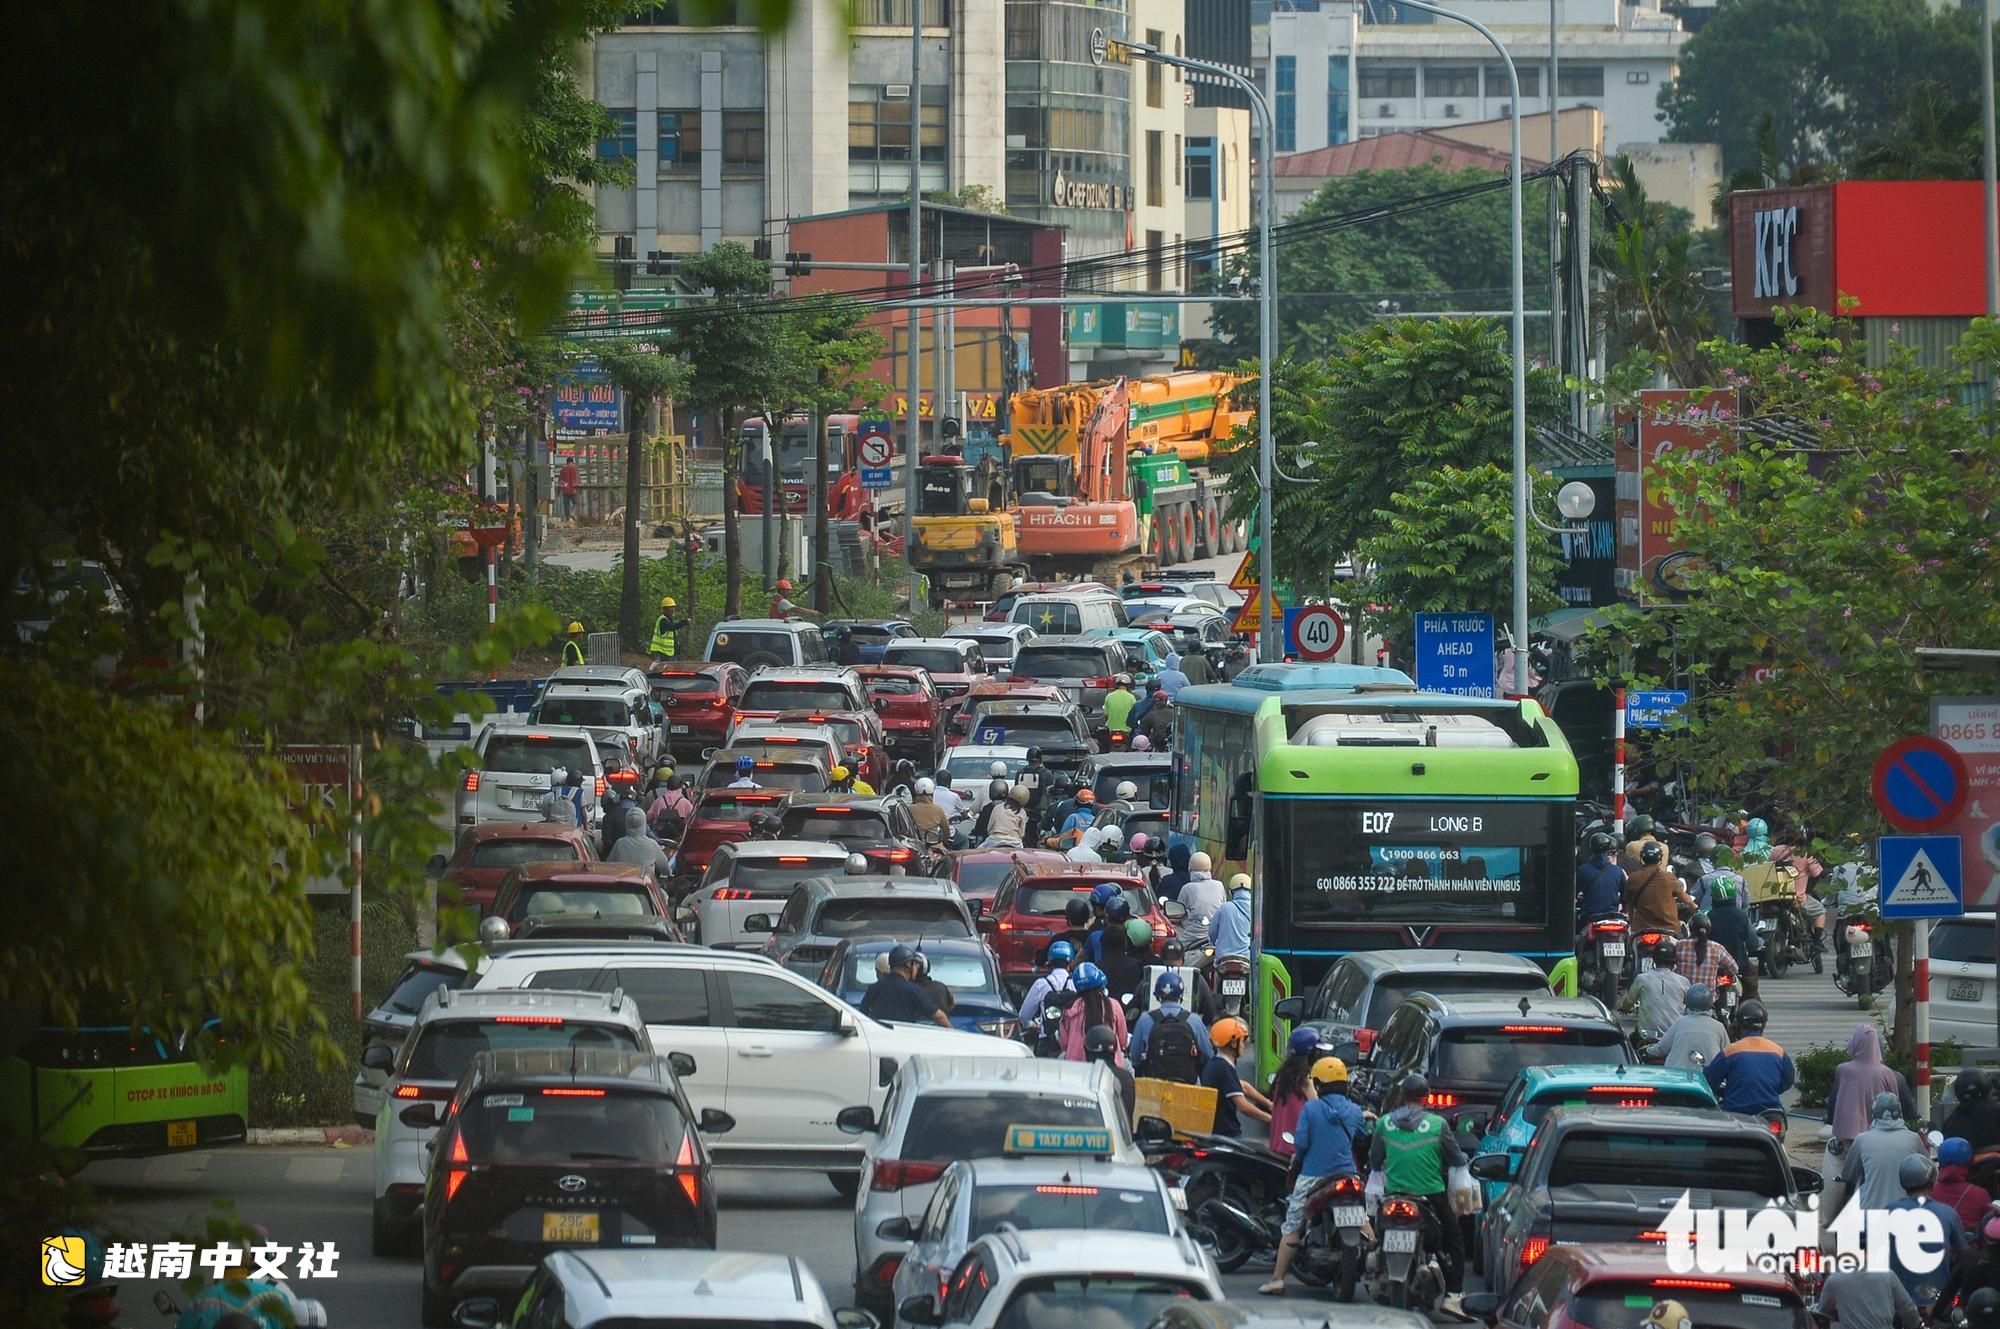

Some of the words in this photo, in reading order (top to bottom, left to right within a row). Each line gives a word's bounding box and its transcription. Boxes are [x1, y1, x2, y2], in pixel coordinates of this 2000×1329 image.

[1754, 206, 1798, 298] KFC
[1030, 513, 1091, 526] HITACHI
[1424, 617, 1448, 633] PHÍA
[1452, 616, 1485, 633] TRƯỚC
[1307, 620, 1329, 644] 40
[1437, 642, 1473, 656] AHEAD
[1443, 664, 1455, 678] 50
[1459, 668, 1468, 678] m
[1651, 694, 1671, 704] PHỐ
[1968, 710, 1986, 719] LIÊN
[1940, 723, 1986, 740] 0865
[1363, 812, 1394, 833] E07
[1430, 816, 1468, 832] LONG
[1473, 816, 1483, 832] B
[1388, 850, 1414, 859] 1900
[1416, 850, 1436, 859] 866
[1440, 850, 1459, 860] 663
[1316, 878, 1332, 892] GỌI
[1333, 875, 1357, 890] 0866
[1358, 876, 1376, 891] 355
[1377, 876, 1395, 891] 222
[1424, 876, 1450, 891] THÀNH
[1451, 877, 1476, 891] NHÂN
[1475, 877, 1492, 891] VIÊN
[1492, 880, 1521, 891] VINBUS
[1039, 1133, 1060, 1146] TAXI
[1064, 1134, 1083, 1147] SAO
